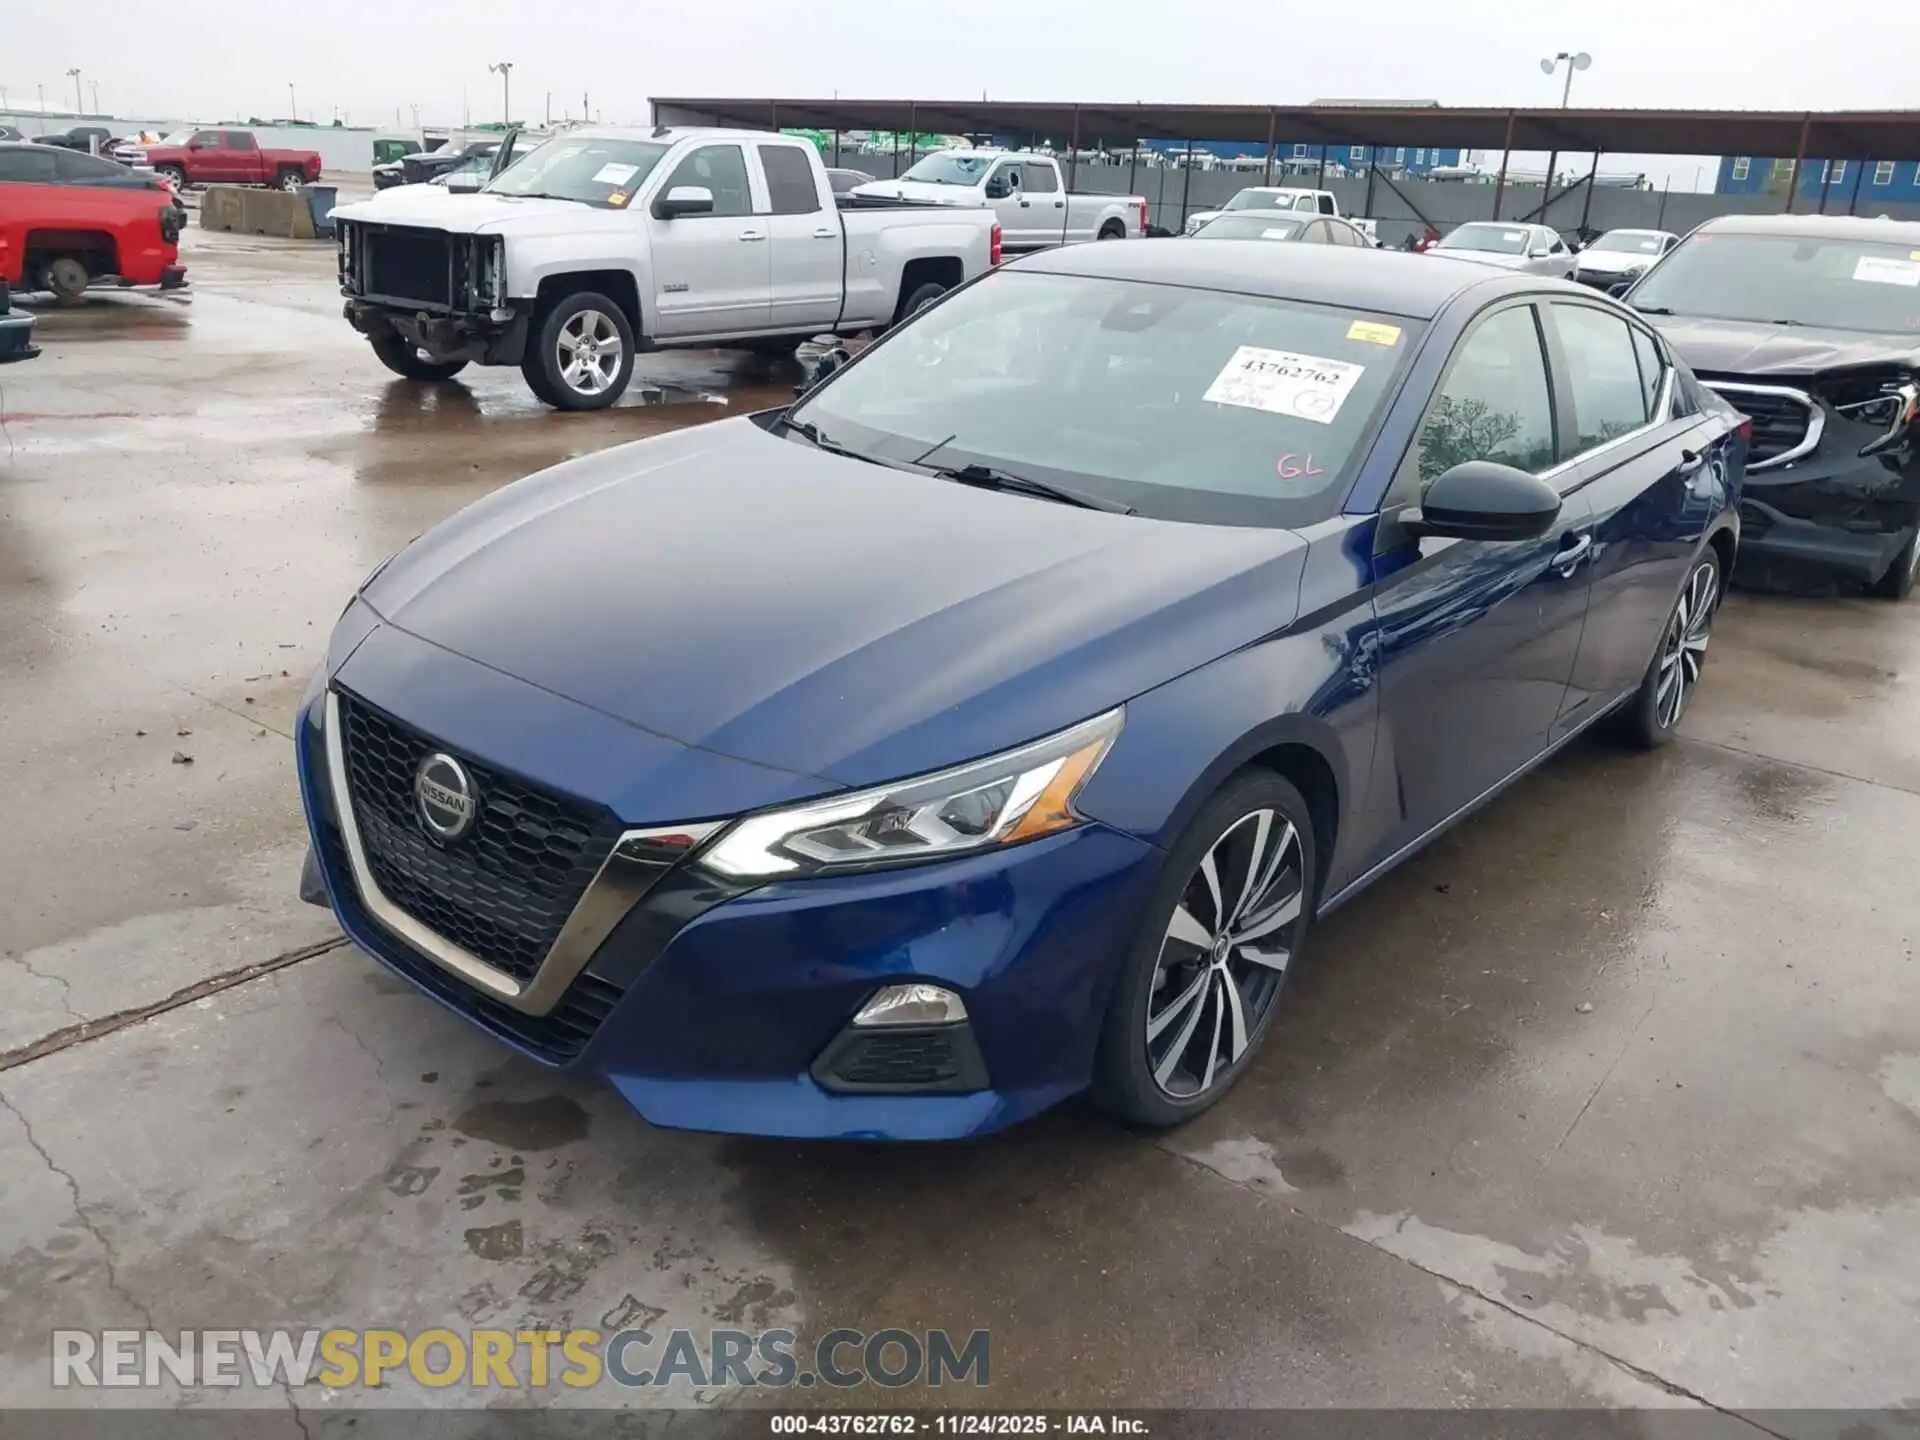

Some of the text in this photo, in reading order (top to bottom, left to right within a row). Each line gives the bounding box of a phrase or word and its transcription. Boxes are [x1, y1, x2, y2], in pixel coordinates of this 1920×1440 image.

[1240, 359, 1341, 385] 43762762
[1277, 453, 1323, 478] GL
[423, 786, 465, 812] NISSAN
